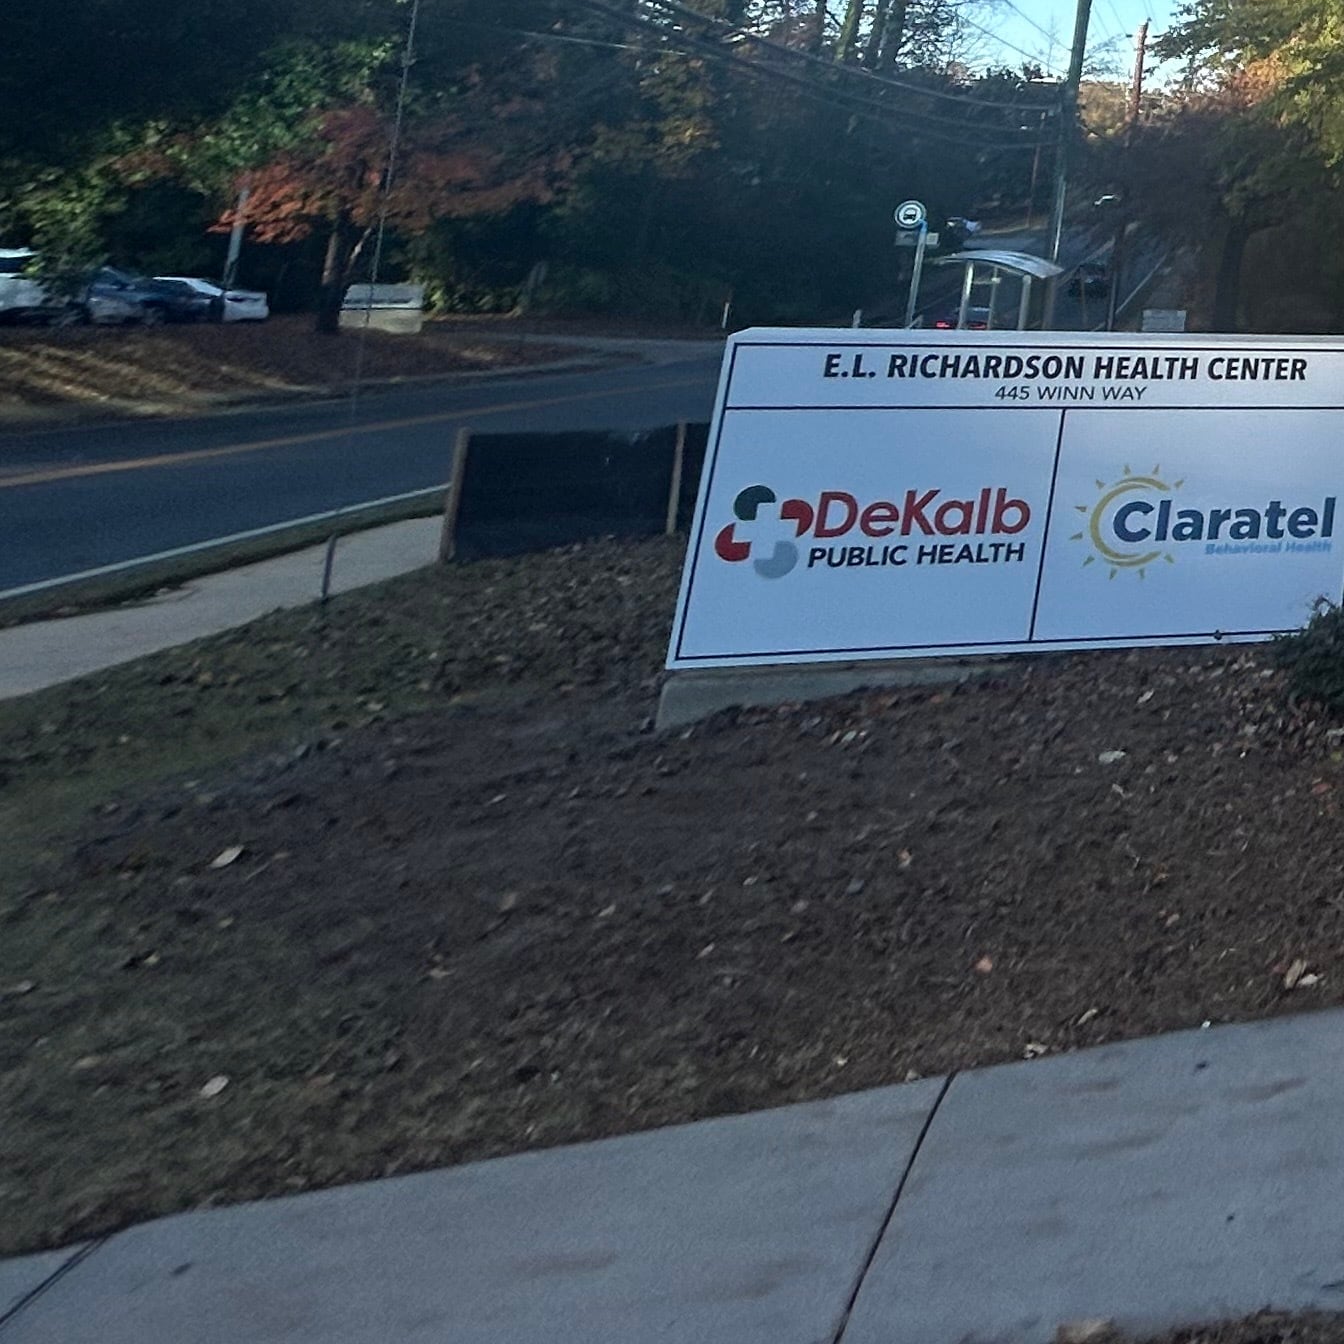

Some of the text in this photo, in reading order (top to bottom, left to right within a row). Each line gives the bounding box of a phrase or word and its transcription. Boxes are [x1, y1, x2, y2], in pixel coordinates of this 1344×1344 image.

[823, 353, 1307, 381] E.L. RICHARDSON HEALTH CENTER
[995, 385, 1147, 400] 445 WINN WAY
[813, 487, 1031, 538] DeKalb
[1112, 497, 1337, 543] Claratel
[808, 542, 1025, 568] PUBLIC HEALTH
[1205, 541, 1332, 555] Behavioral Health
